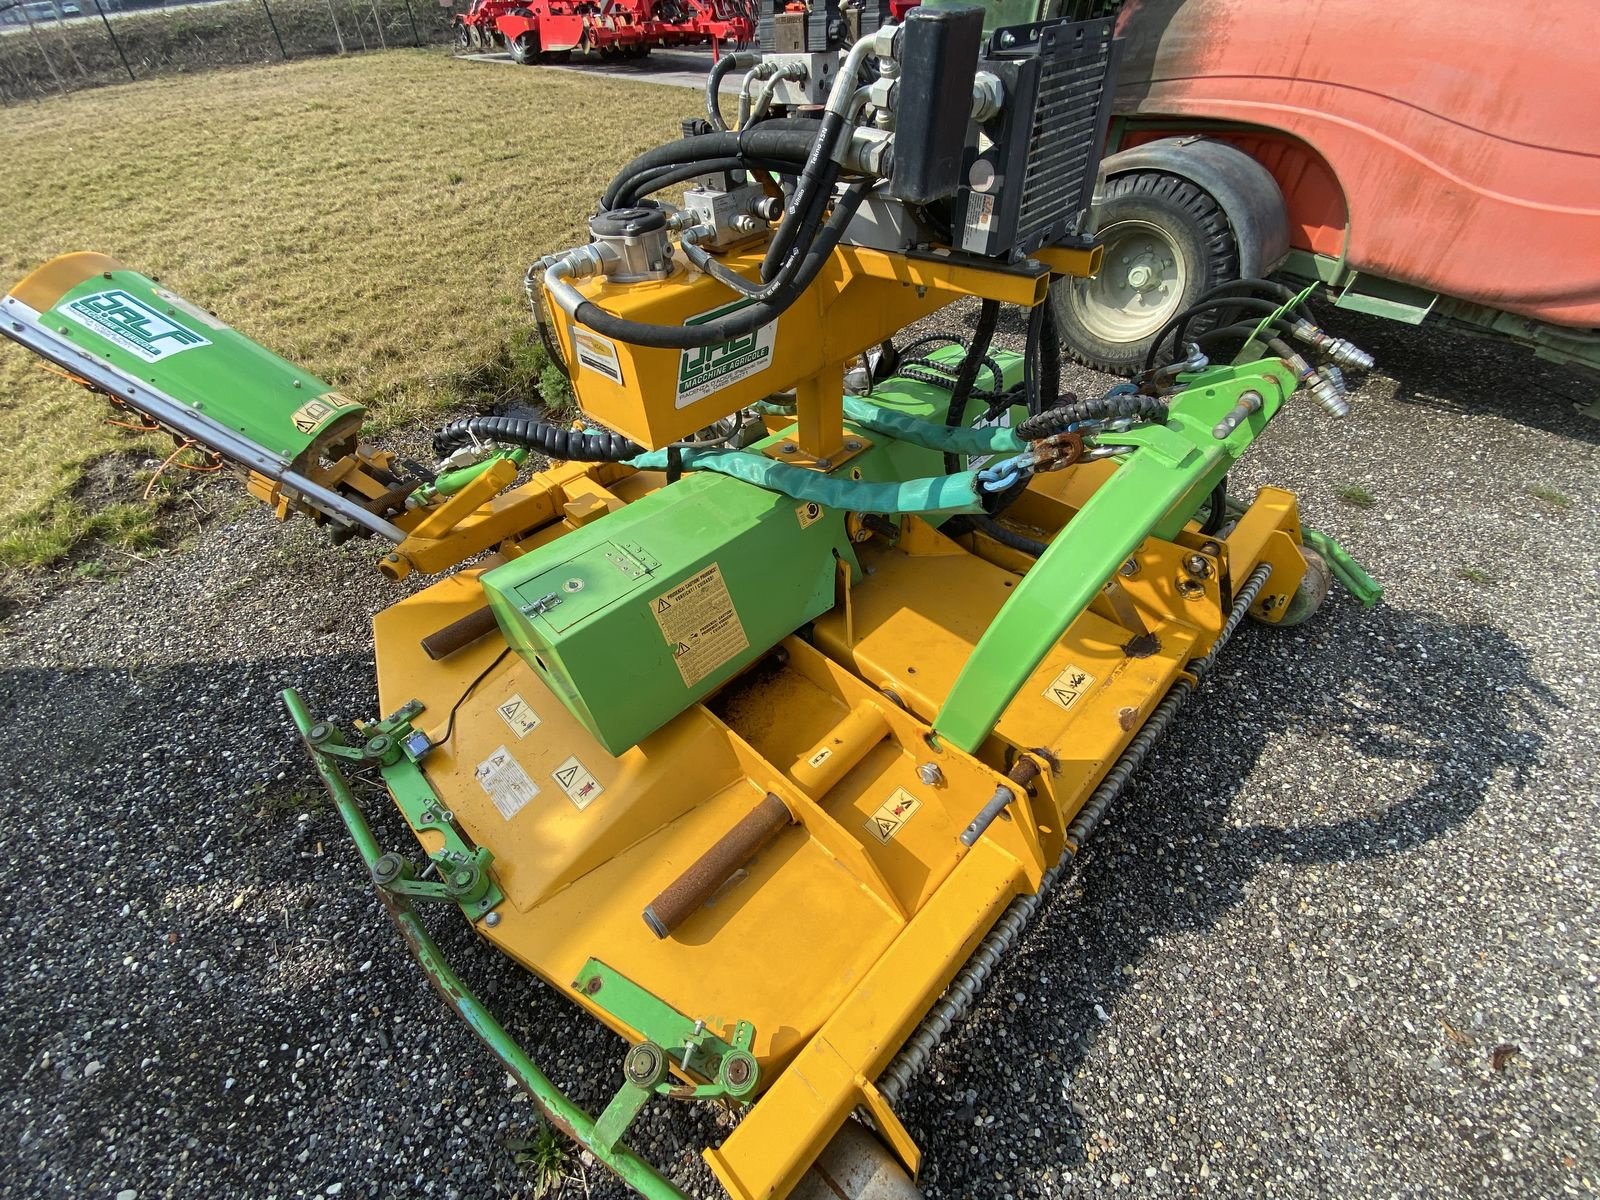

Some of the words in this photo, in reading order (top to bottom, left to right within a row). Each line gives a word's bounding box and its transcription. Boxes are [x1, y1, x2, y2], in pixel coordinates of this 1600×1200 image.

[810, 143, 822, 165] Tekno
[818, 127, 829, 142] 1SN
[684, 366, 728, 390] MACCHINE
[729, 348, 766, 371] AGRICOLE
[679, 383, 711, 401] PIACENZA
